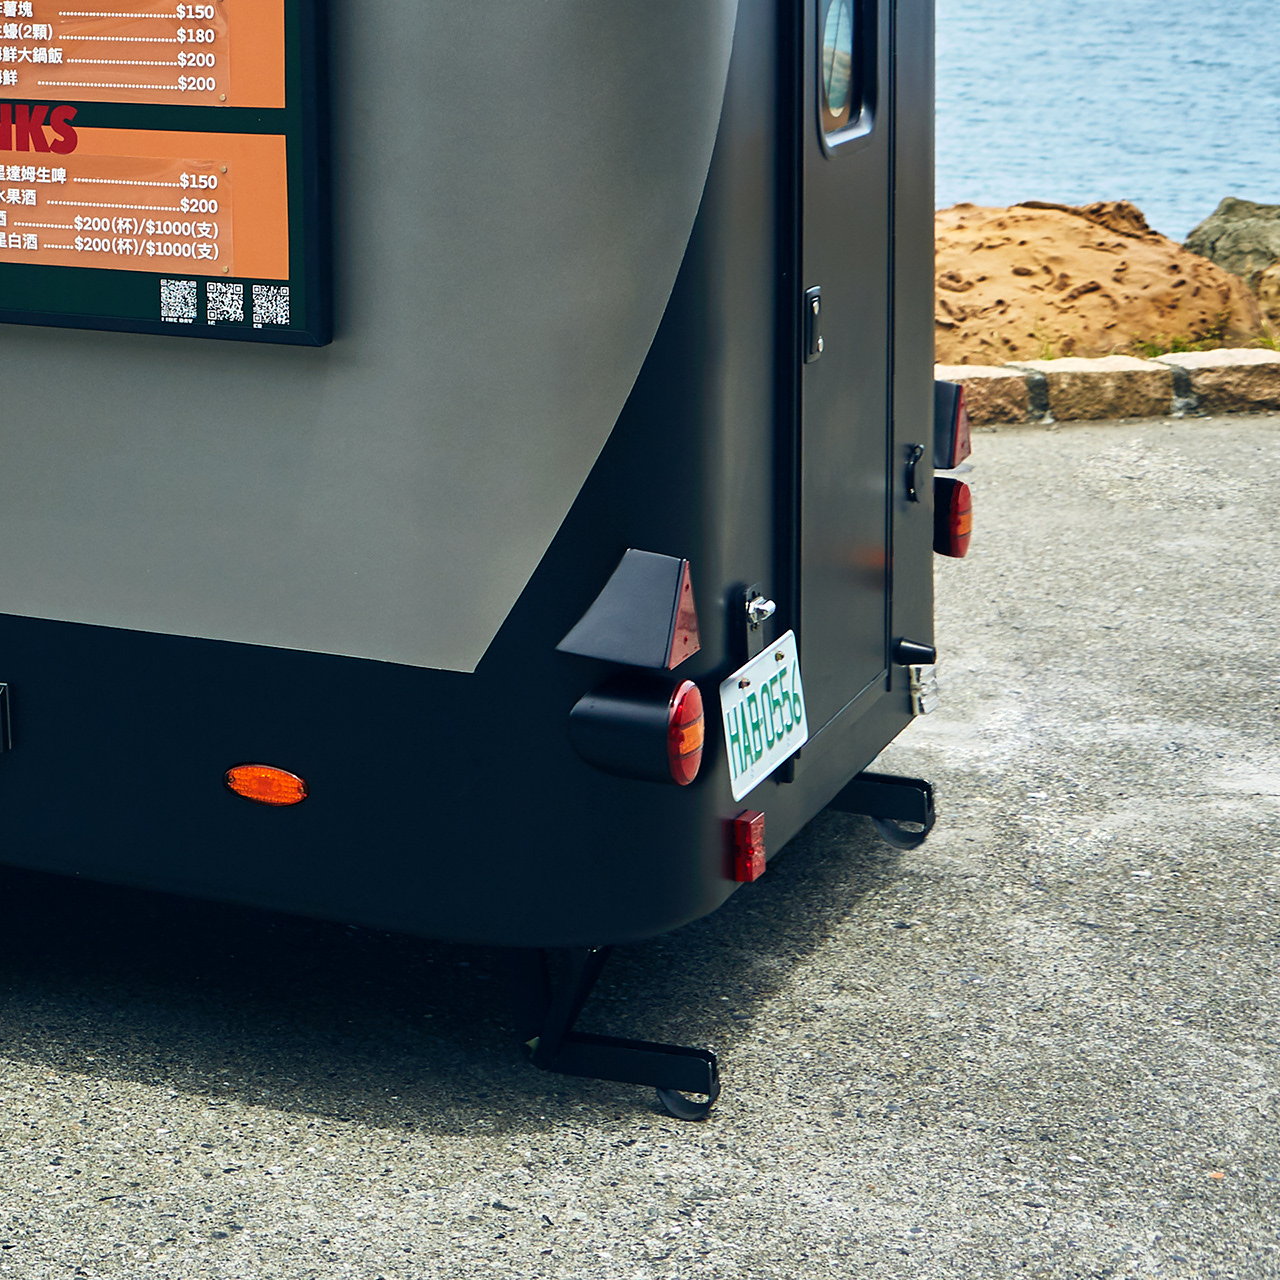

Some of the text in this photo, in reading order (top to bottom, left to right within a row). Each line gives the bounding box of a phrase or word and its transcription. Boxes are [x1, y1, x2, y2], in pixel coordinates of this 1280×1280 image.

[176, 4, 215, 21] $150
[176, 26, 215, 44] $180
[177, 51, 216, 69] $200
[178, 74, 216, 93] $200
[179, 172, 218, 190] $150
[180, 196, 219, 214] $200
